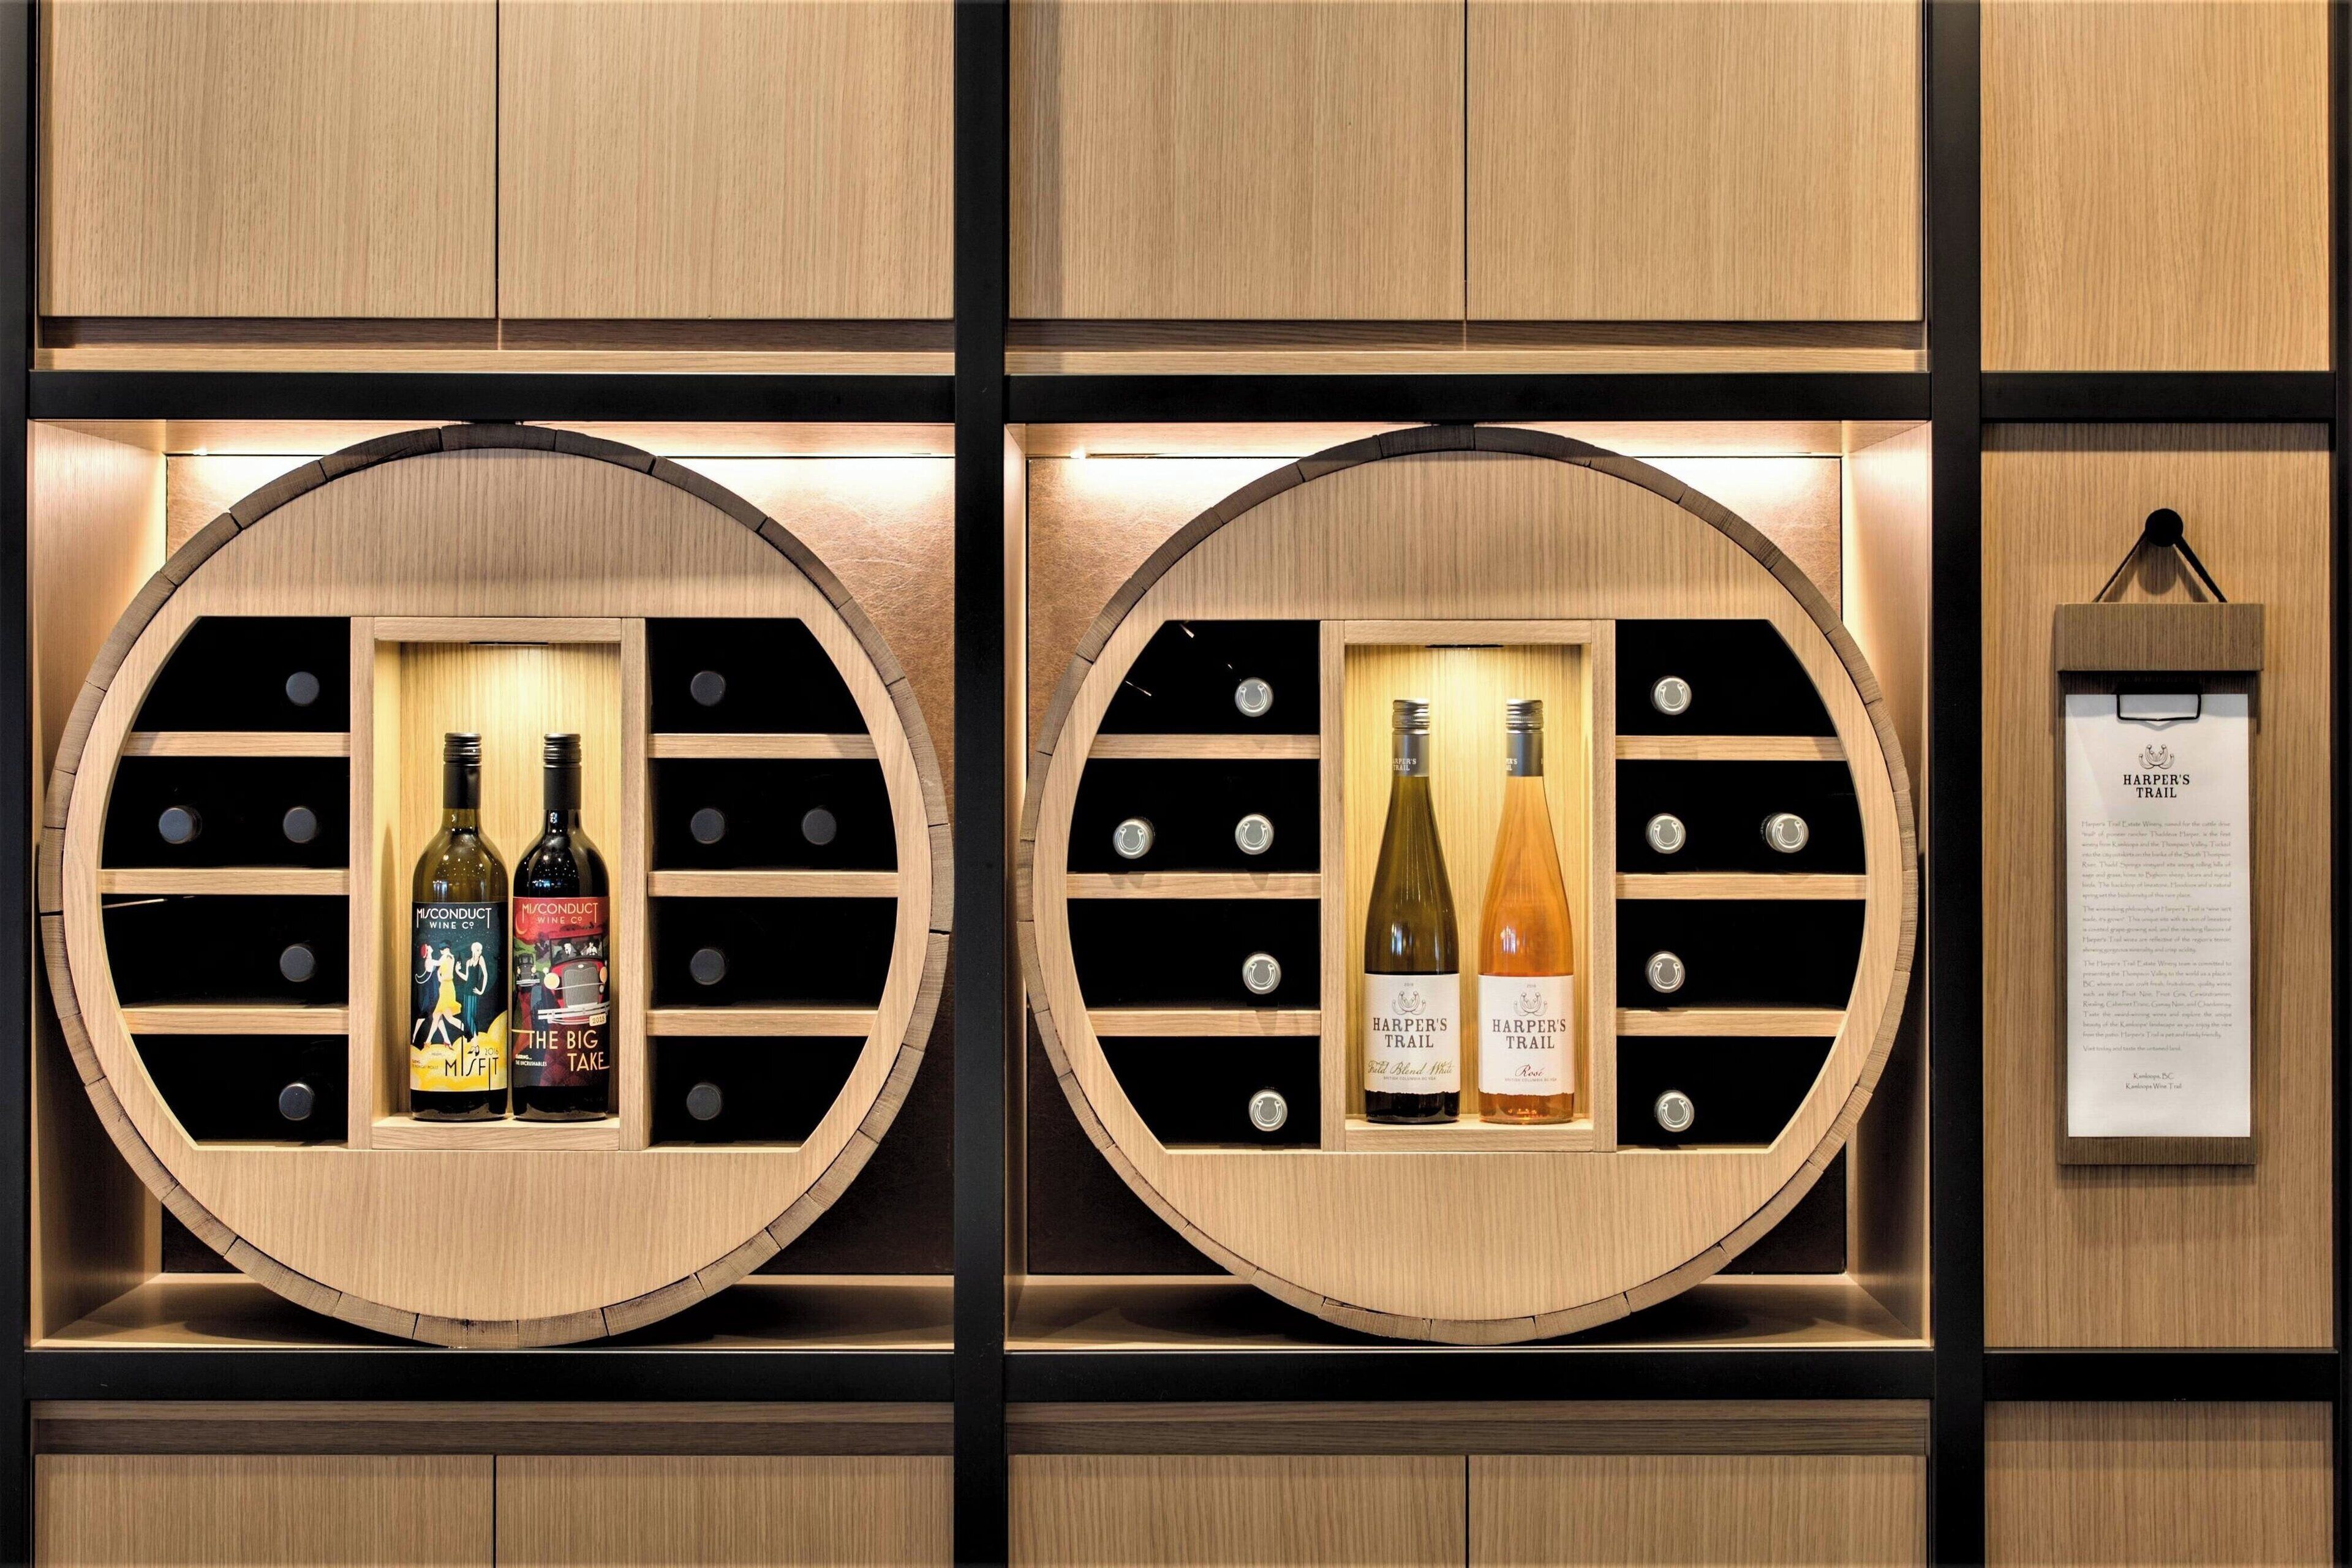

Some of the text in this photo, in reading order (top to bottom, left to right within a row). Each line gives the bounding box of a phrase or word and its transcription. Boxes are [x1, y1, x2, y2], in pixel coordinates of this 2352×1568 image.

[2123, 774, 2190, 785] HARPER'S
[2136, 787, 2177, 798] TRAIL
[417, 908, 492, 929] MISCONDUCT
[522, 902, 598, 924] MISCONDUCT
[1373, 1017, 1447, 1032] HARPER'S
[1492, 1019, 1566, 1033] HARPER'S
[512, 1029, 598, 1049] THE BIG
[1385, 1035, 1434, 1048] TRAIL
[1506, 1036, 1555, 1049] TRAIL
[567, 1052, 609, 1072] TAKE
[1368, 1060, 1454, 1076] Field Blend White
